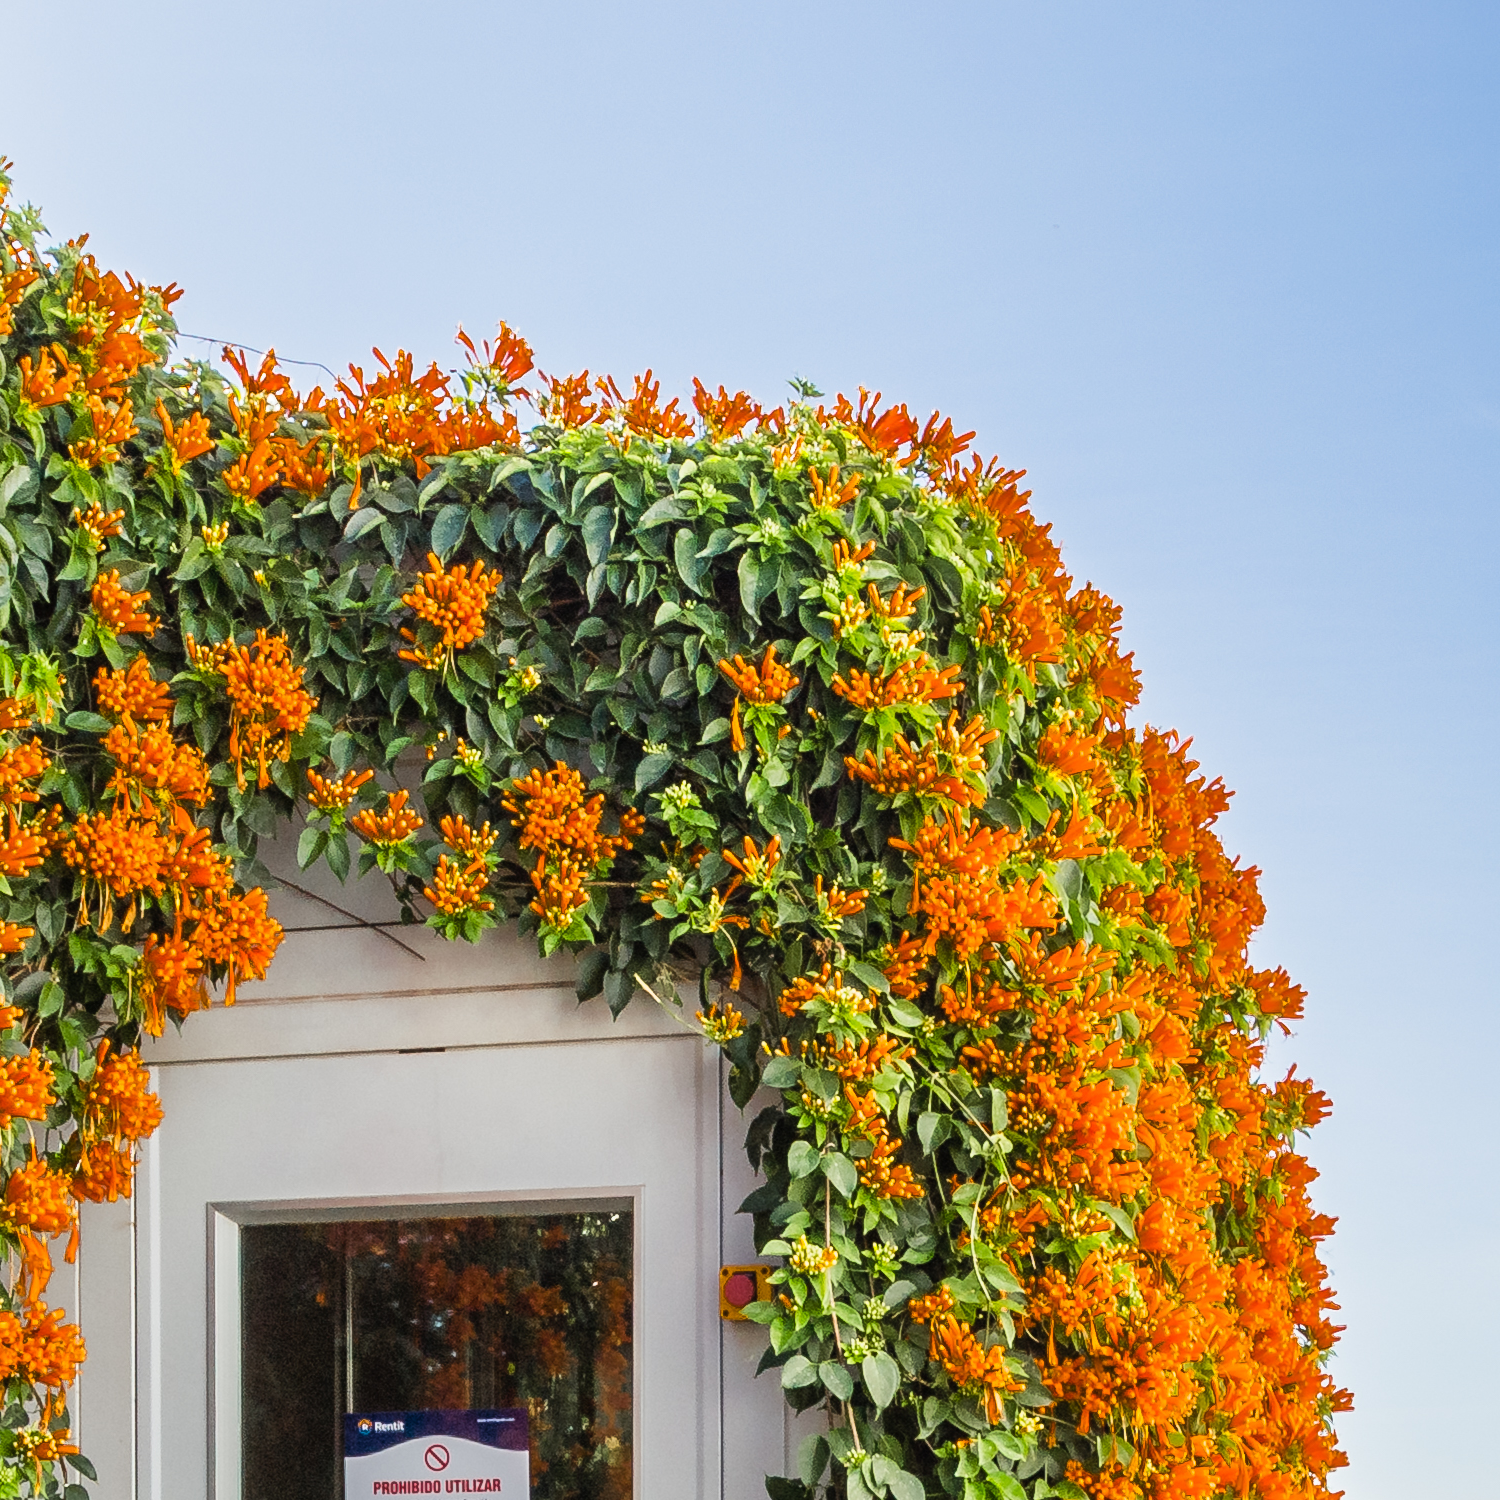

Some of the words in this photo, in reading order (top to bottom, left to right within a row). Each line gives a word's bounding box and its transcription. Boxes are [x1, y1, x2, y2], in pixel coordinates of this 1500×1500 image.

[374, 1420, 405, 1431] Rentit
[373, 1480, 442, 1495] PROHIBIDO
[445, 1478, 502, 1494] UTILIZAR
